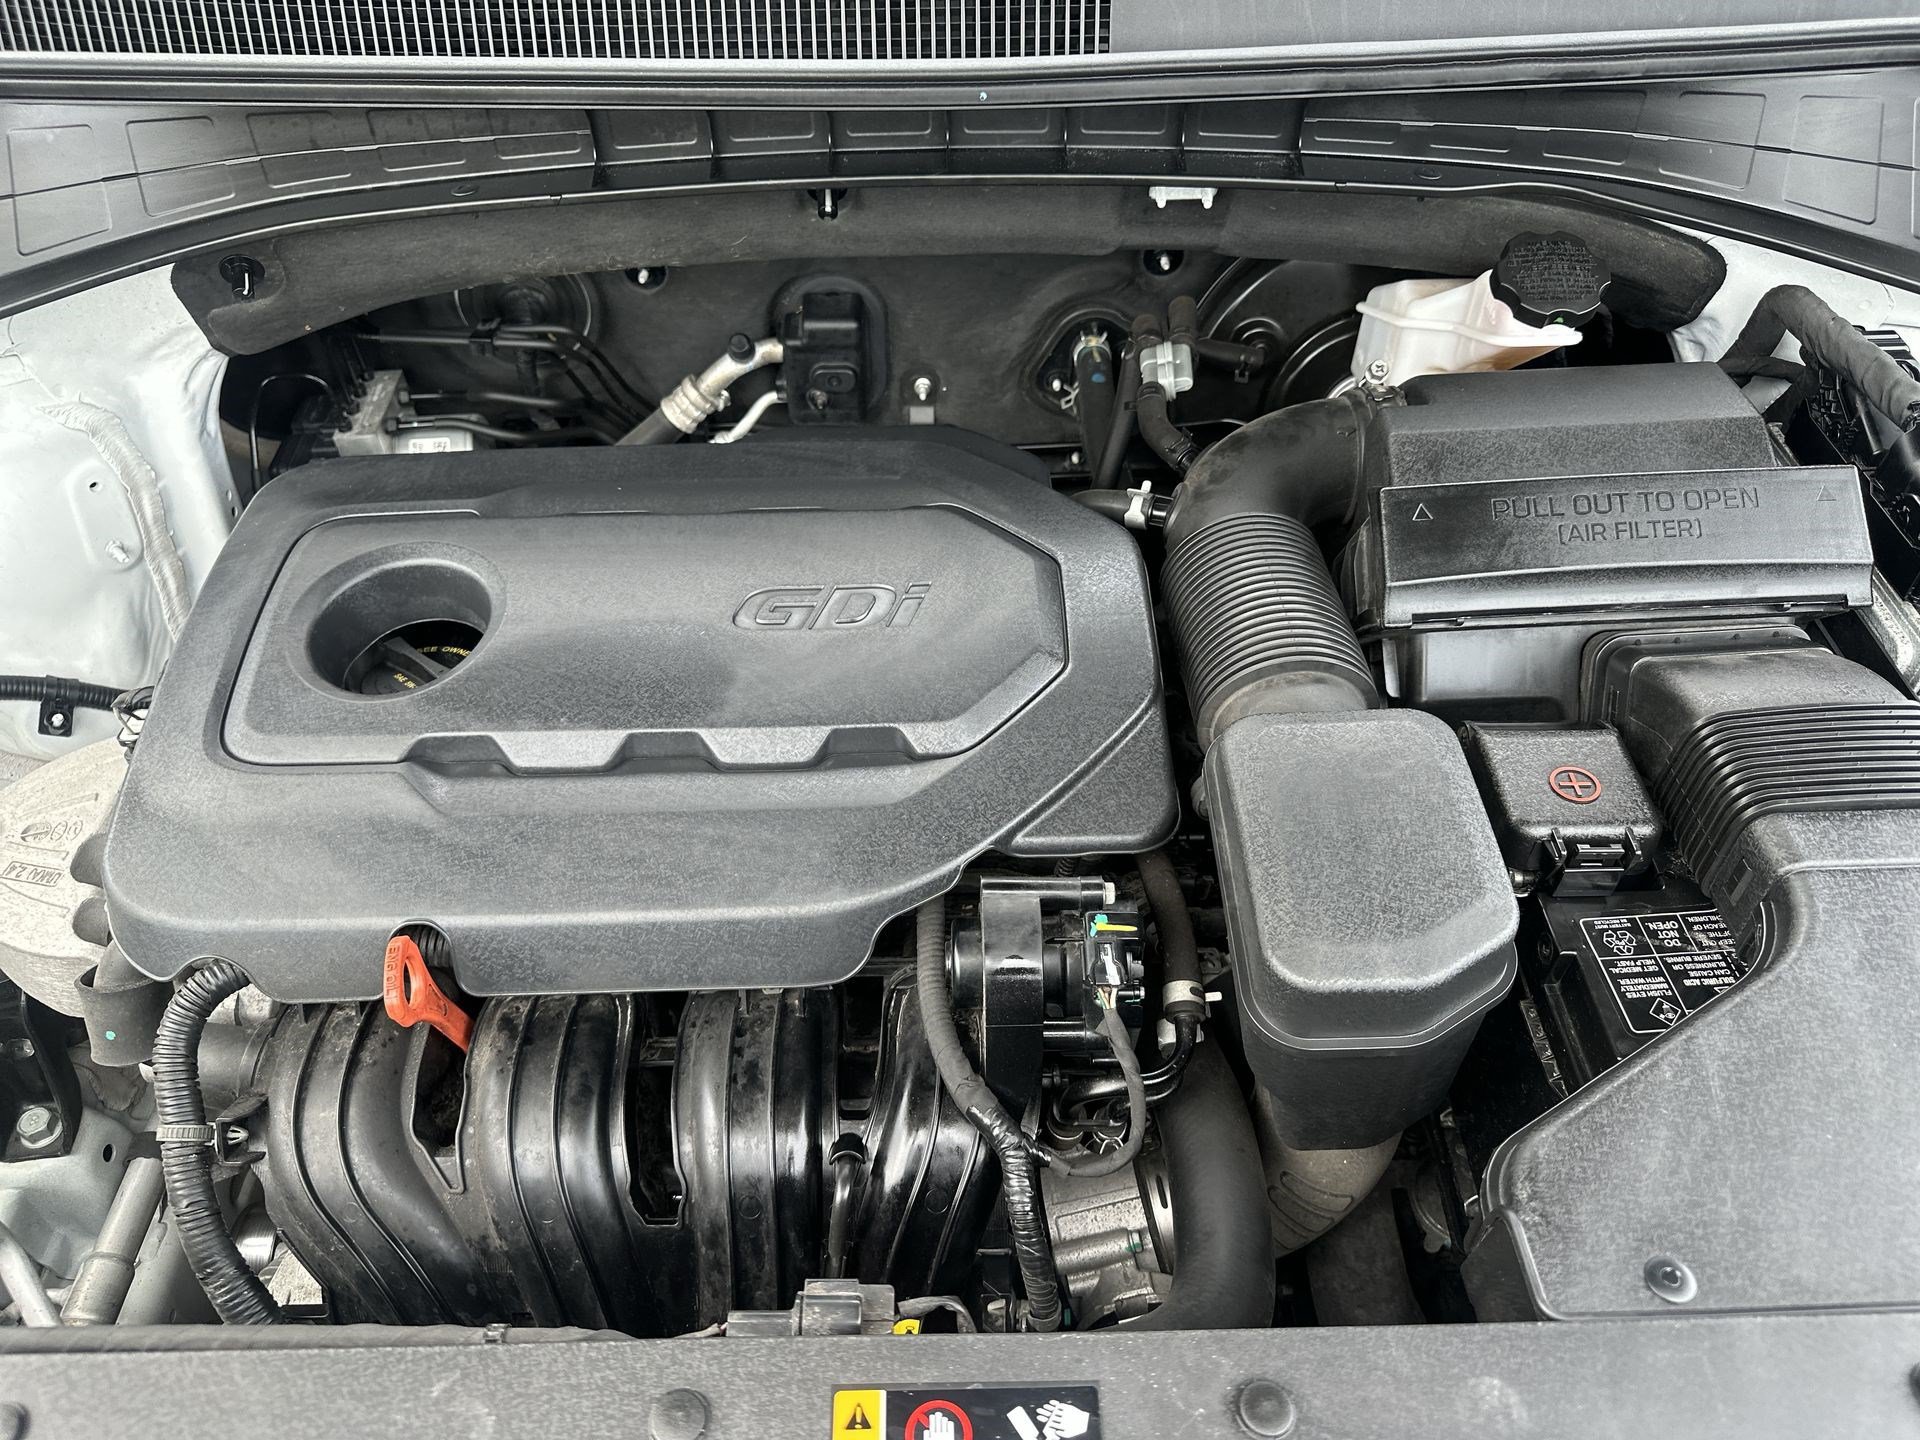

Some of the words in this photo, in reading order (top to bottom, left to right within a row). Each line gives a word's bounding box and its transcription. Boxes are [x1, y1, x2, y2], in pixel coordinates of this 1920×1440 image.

[1490, 496, 1565, 520] PULL
[1572, 492, 1630, 516] OUT
[1635, 490, 1676, 513] TO
[1682, 487, 1760, 511] OPEN
[732, 580, 932, 630] GDi
[1645, 921, 1679, 931] OPEN.
[1657, 930, 1680, 939] NOT
[1664, 938, 1681, 947] DO
[387, 944, 400, 972] ENG
[1663, 955, 1690, 963] BURNS.
[1691, 953, 1722, 962] SEVERE
[1609, 966, 1643, 974] MEDICAL
[1684, 961, 1727, 970] BLINDNESS
[1688, 970, 1713, 978] CAUSE
[1713, 968, 1731, 976] CAN
[386, 973, 399, 996] OIL
[1646, 976, 1666, 984] WITH
[1683, 978, 1701, 987] ACID
[1700, 976, 1735, 986] SULFURIC
[1620, 983, 1670, 992] IMMEDIATELY
[1625, 990, 1647, 999] EYES
[1647, 989, 1673, 998] FLUSH
